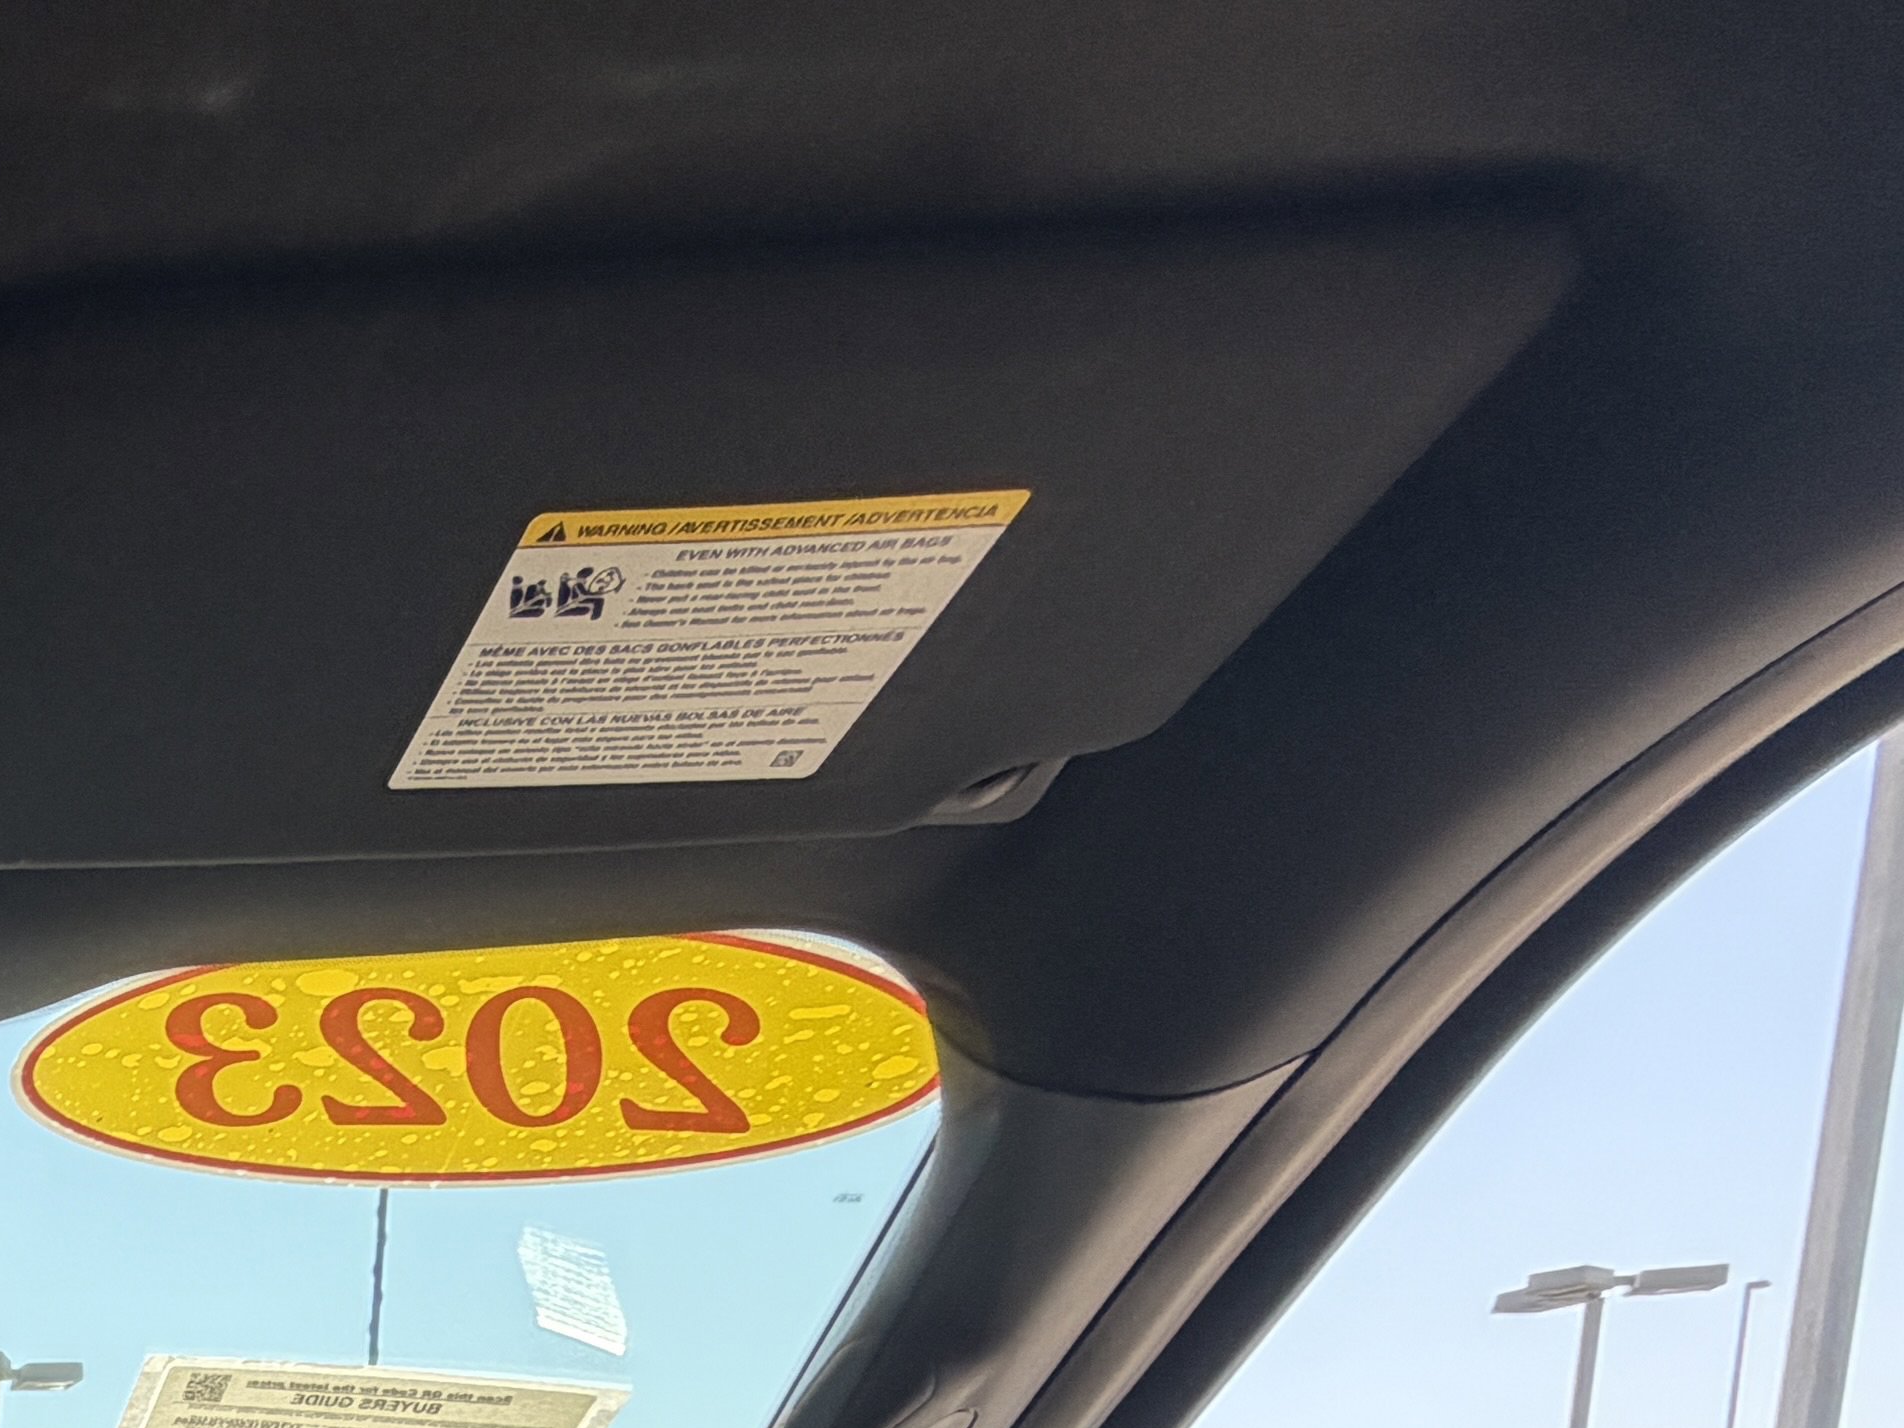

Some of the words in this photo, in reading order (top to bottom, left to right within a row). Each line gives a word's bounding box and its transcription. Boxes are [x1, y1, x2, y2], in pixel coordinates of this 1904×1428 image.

[577, 522, 667, 537] WARNING
[676, 549, 722, 561] EVEN
[725, 547, 769, 560] WITH
[771, 541, 867, 556] ADVANCED
[868, 538, 899, 549] AIR
[900, 536, 952, 548] BAGS
[527, 646, 571, 657] AVEC
[573, 645, 608, 656] DES
[539, 716, 574, 727] CON
[576, 715, 607, 725] LAS
[741, 709, 762, 719] DE
[765, 706, 807, 717] AIRE
